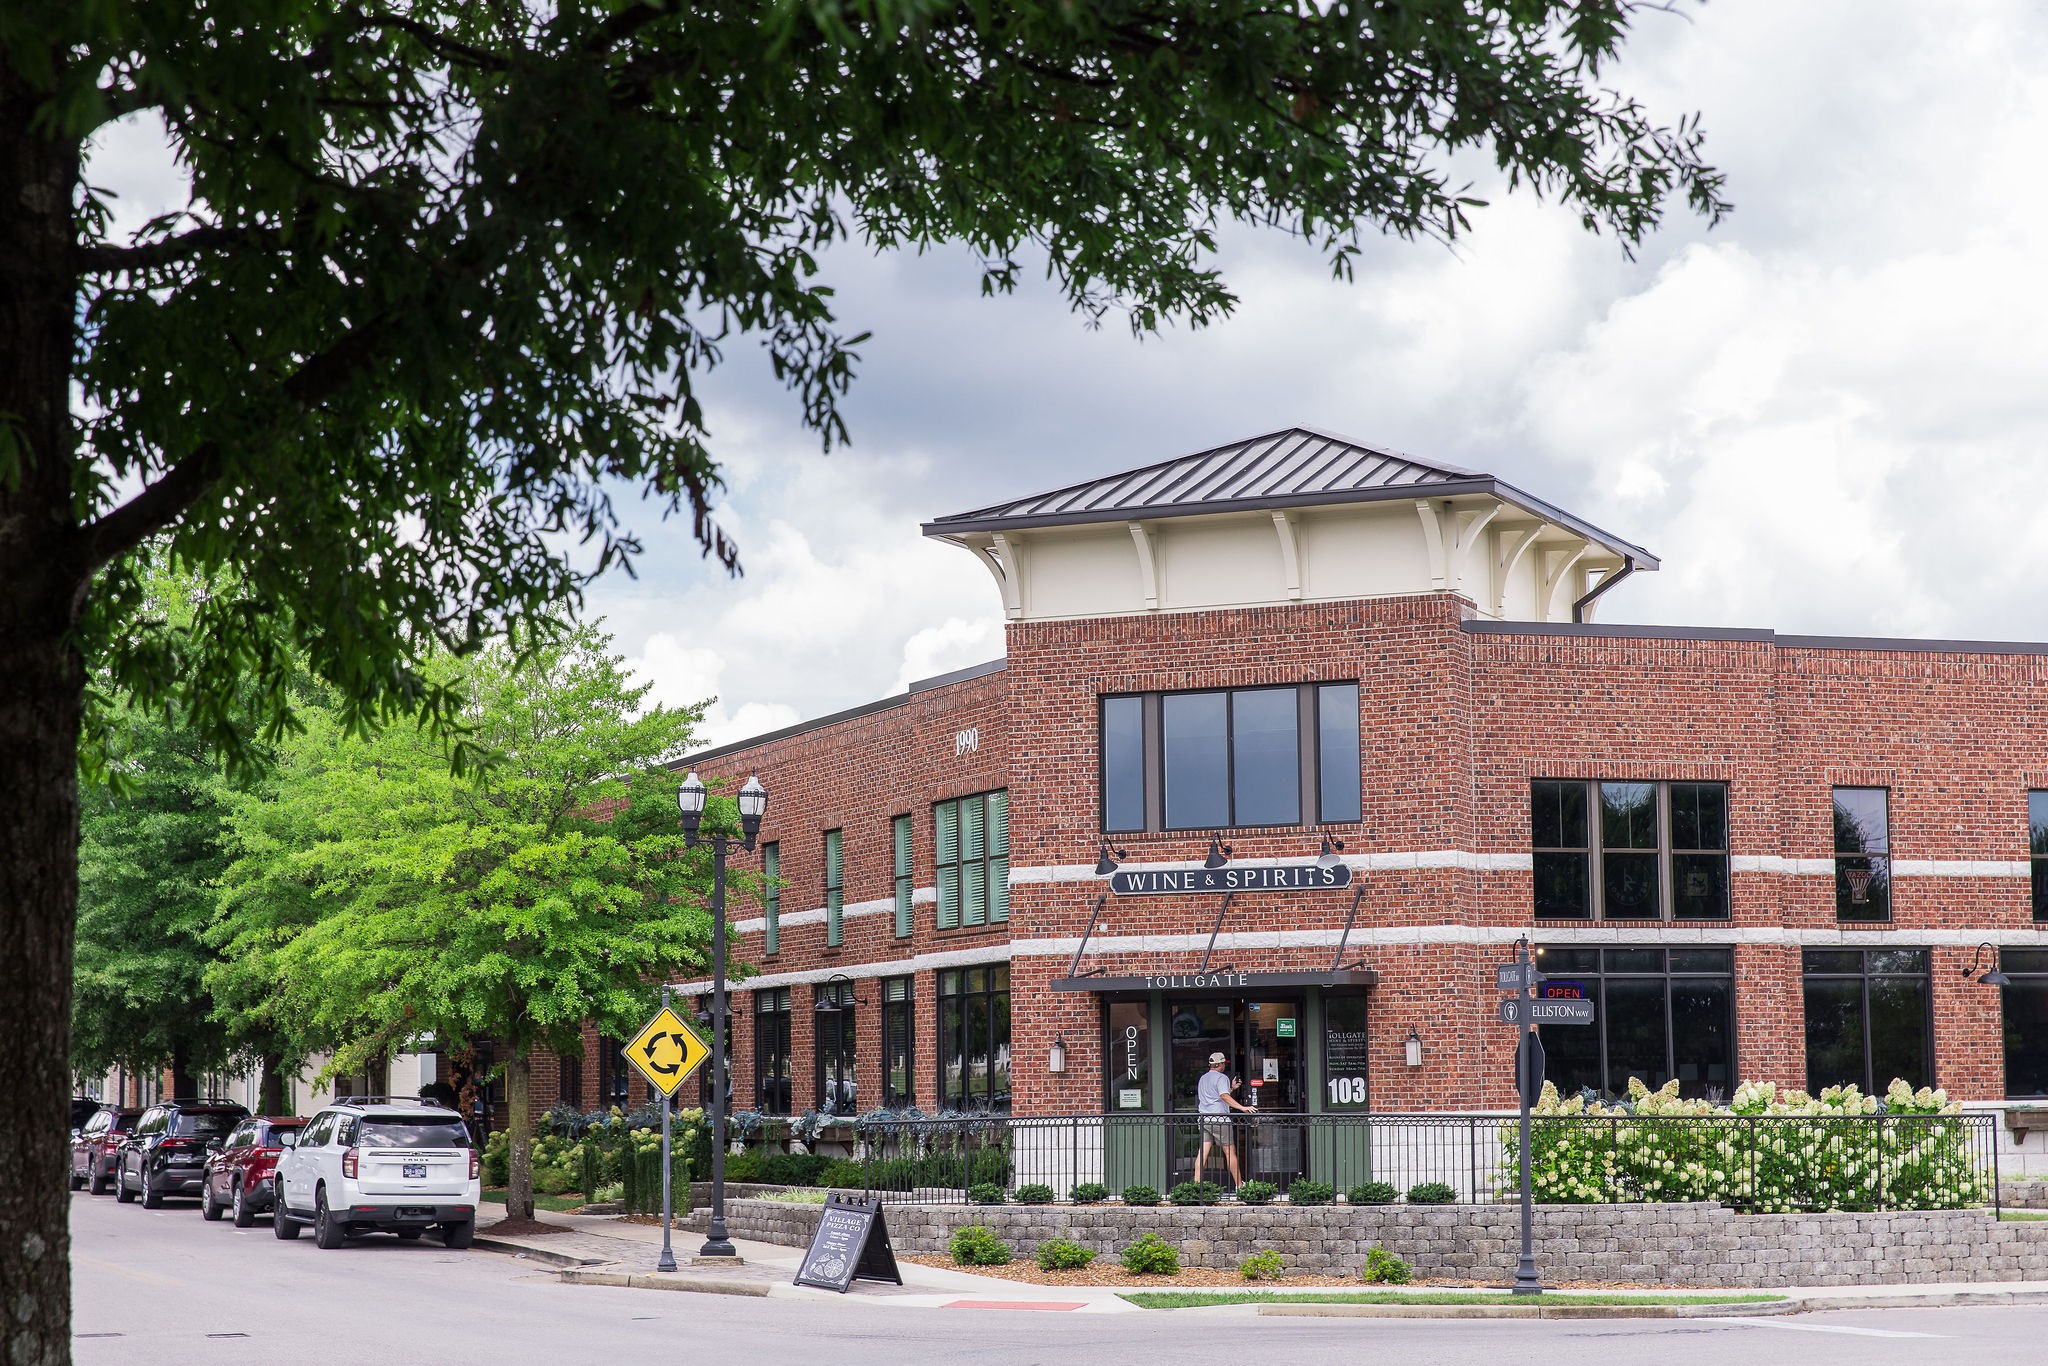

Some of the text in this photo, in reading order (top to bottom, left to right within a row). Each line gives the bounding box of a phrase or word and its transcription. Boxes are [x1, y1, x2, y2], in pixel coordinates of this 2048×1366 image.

[956, 728, 978, 756] 1990
[1127, 867, 1335, 891] WINE & SPIRITS
[1145, 973, 1248, 988] TOLLGATE
[1547, 988, 1580, 998] OPEN
[1532, 1005, 1574, 1017] ELLISTON
[1328, 1030, 1366, 1039] TOLLGATE
[1126, 1026, 1138, 1080] OPEN
[1328, 1077, 1366, 1104] 103
[826, 1222, 847, 1230] PIZZA
[830, 1216, 861, 1226] VILLAGE
